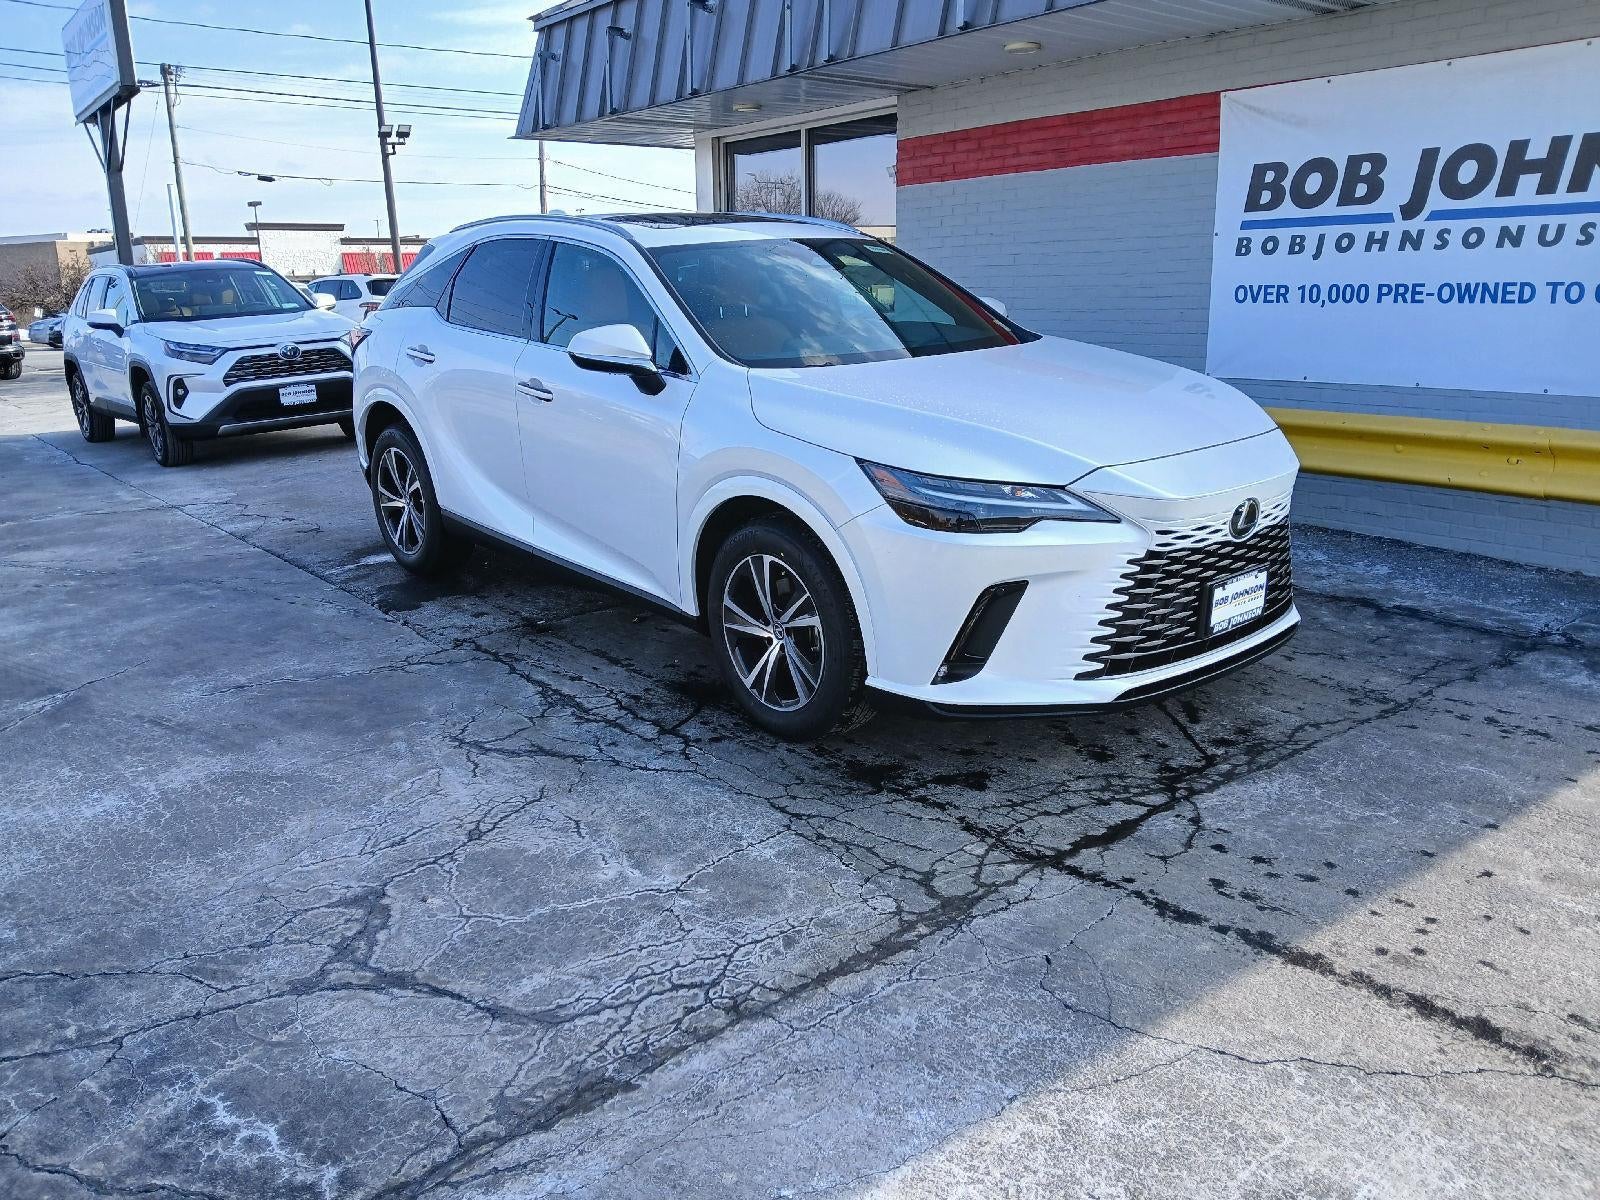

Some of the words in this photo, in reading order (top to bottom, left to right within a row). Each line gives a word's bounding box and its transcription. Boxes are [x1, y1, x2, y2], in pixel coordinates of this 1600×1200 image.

[1243, 152, 1388, 213] BOB
[1234, 221, 1598, 261] BOBJOHNSONUS
[1233, 284, 1290, 304] OVER
[1297, 283, 1370, 308] 10,000
[1376, 281, 1537, 305] PRE-OWNED
[1546, 281, 1586, 305] TO
[1214, 595, 1230, 608] BOB
[1229, 583, 1265, 604] JOHNSON
[1213, 619, 1230, 633] BOB
[1229, 606, 1263, 629] JOHNSON
